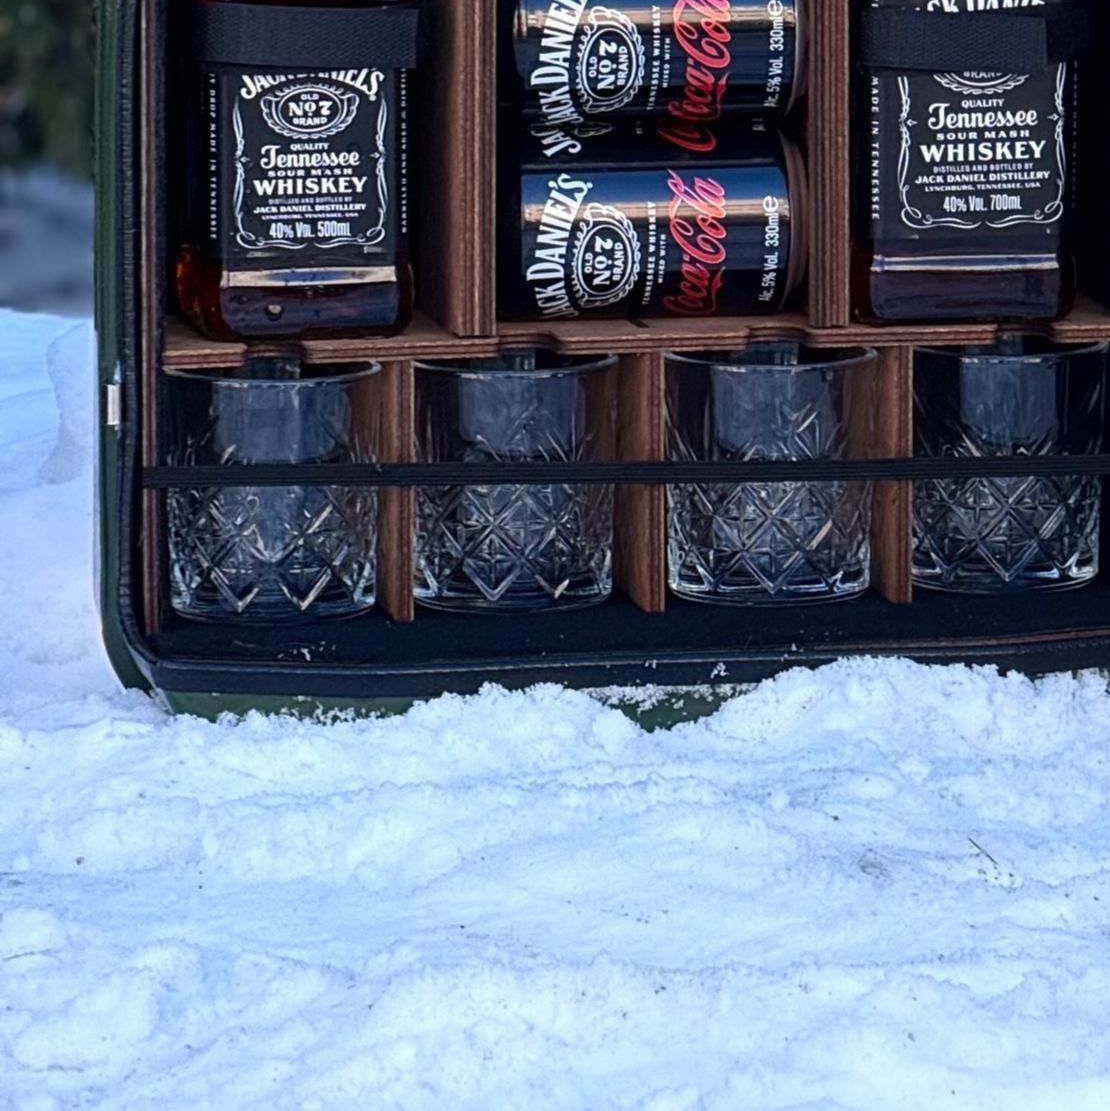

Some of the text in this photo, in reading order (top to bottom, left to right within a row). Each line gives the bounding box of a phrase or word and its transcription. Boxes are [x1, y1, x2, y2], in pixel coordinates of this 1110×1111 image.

[588, 56, 598, 78] OLD
[617, 45, 630, 86] BRAND
[646, 4, 661, 111] TENNESSEE WHISKEY
[766, 75, 782, 93] 5%
[538, 91, 584, 125] JACK
[961, 99, 1004, 108] QUALITY
[293, 117, 328, 126] BRAND
[928, 103, 1038, 130] Tennessee
[936, 129, 1030, 141] SOUR MASH
[260, 144, 360, 169] Tennessee
[290, 142, 330, 151] QUALITY
[871, 76, 880, 221] MADE IN TENNESSEE
[920, 140, 1046, 163] WHISKEY
[268, 168, 353, 177] SOUR MASH
[915, 171, 1050, 184] JACK DANIEL DISTILLERY
[933, 162, 1034, 173] DISTILLED AND BOTTLED BY
[253, 176, 368, 196] WHISKEY
[253, 203, 367, 214] JACK DANIEL DISTILLERY
[943, 196, 967, 213] 40%
[269, 222, 294, 239] 40%
[526, 173, 589, 282] DANIEL'S
[647, 201, 657, 253] WHISKEY
[584, 252, 593, 274] OLD
[612, 242, 625, 281] BRAND
[762, 273, 777, 288] 5%
[534, 286, 580, 319] JACK
